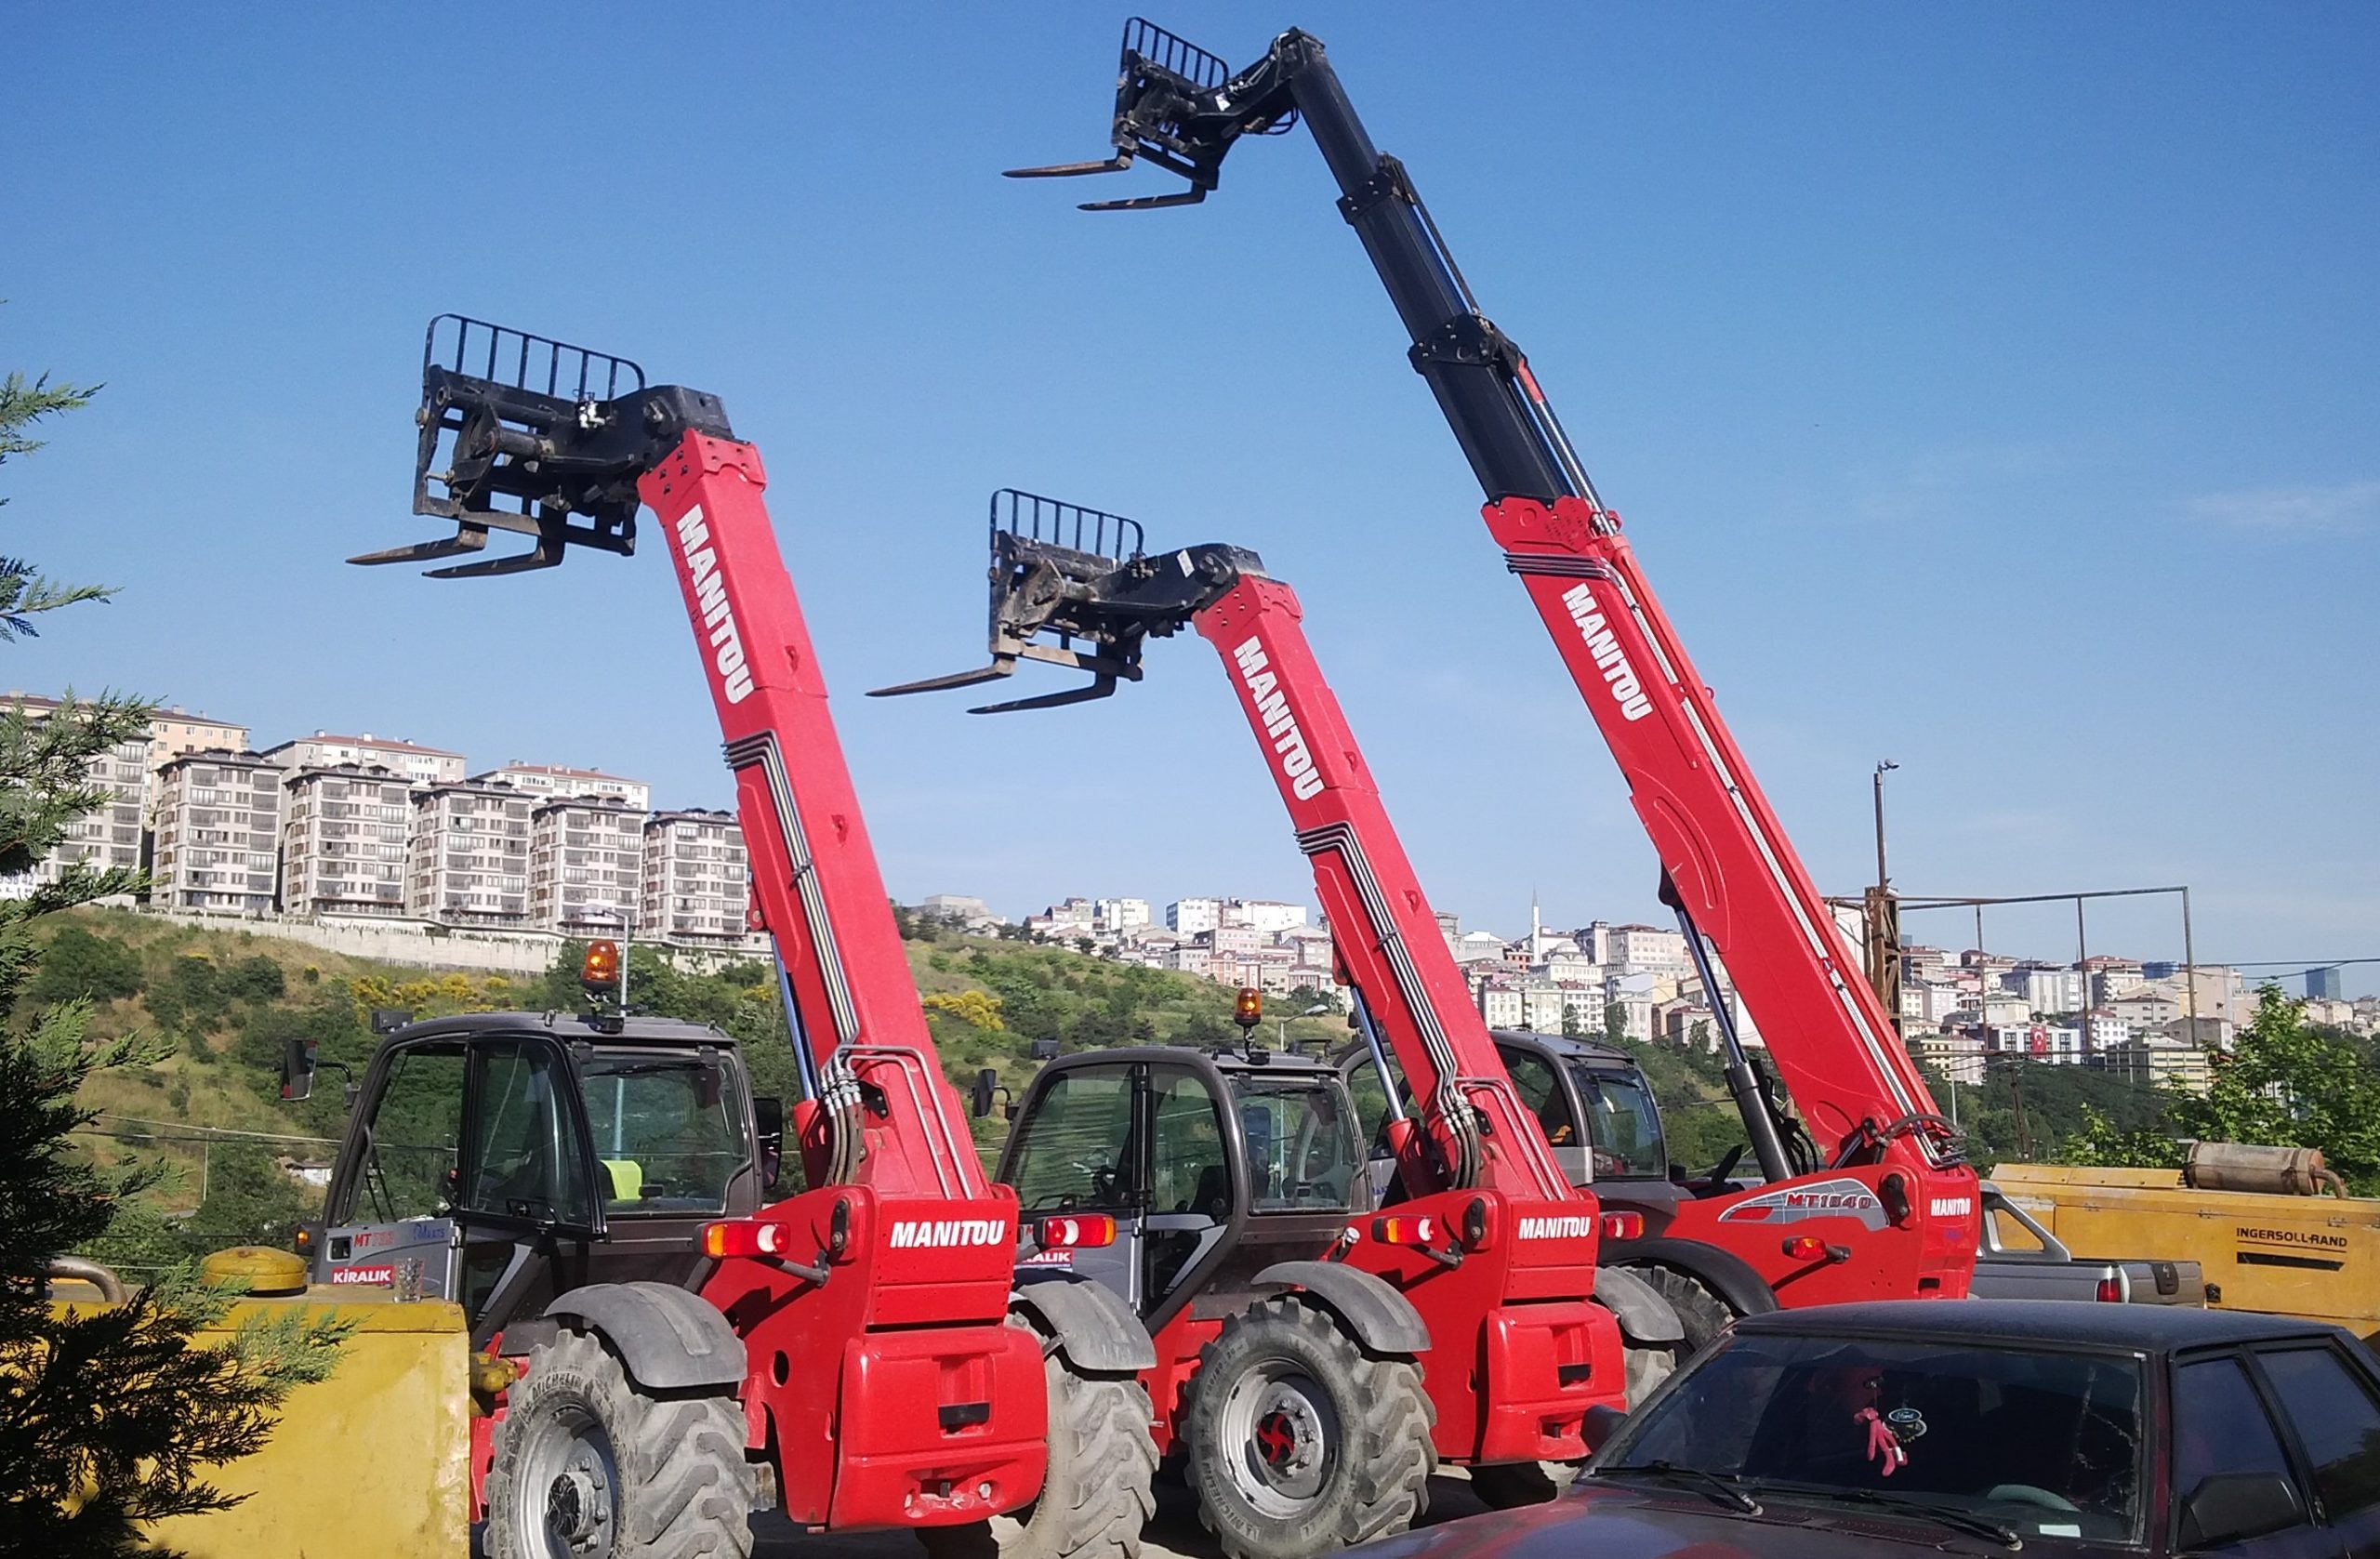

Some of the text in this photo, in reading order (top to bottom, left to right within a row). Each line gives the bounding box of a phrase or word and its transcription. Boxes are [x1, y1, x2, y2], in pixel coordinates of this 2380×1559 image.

[676, 503, 755, 704] MANITOU
[1561, 582, 1653, 721] MANITOU
[1233, 635, 1325, 801] MANITOU
[1931, 1197, 1971, 1216] MANITOU
[890, 1220, 1005, 1248] MANITOU
[1518, 1216, 1591, 1239] MANITOU
[2236, 1227, 2347, 1248] INGERSOLL-RAND
[333, 1268, 391, 1284] KİRALIK
